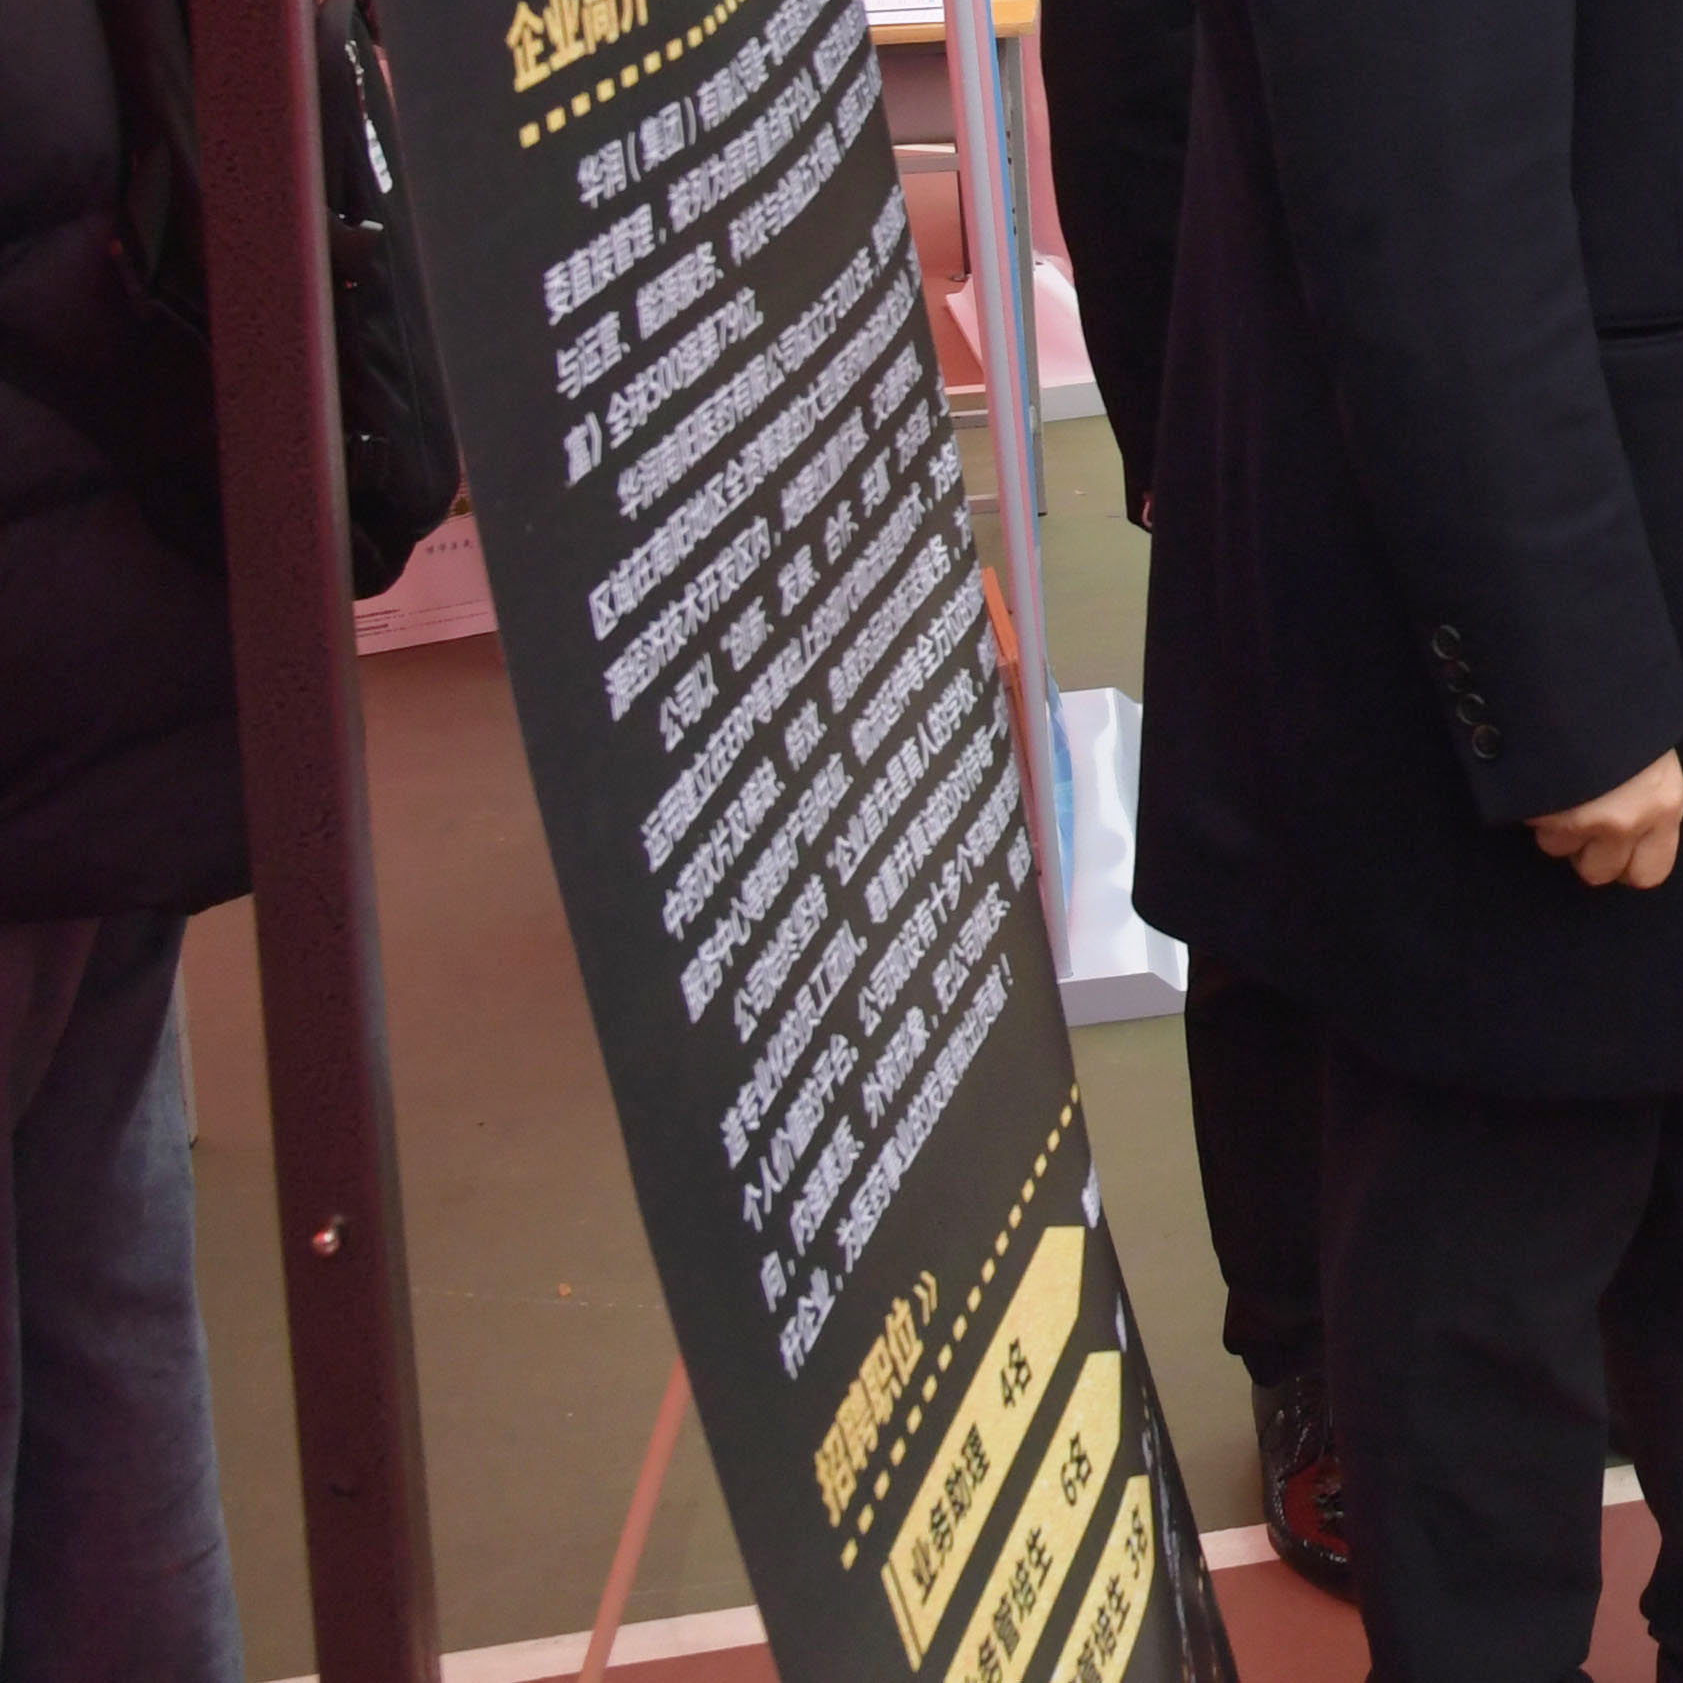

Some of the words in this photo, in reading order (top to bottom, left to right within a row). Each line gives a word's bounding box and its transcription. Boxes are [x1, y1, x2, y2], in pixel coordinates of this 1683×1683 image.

[909, 1421, 991, 1607] 业务助理
[1000, 1337, 1033, 1410] 4名
[1060, 1431, 1094, 1508] 6名
